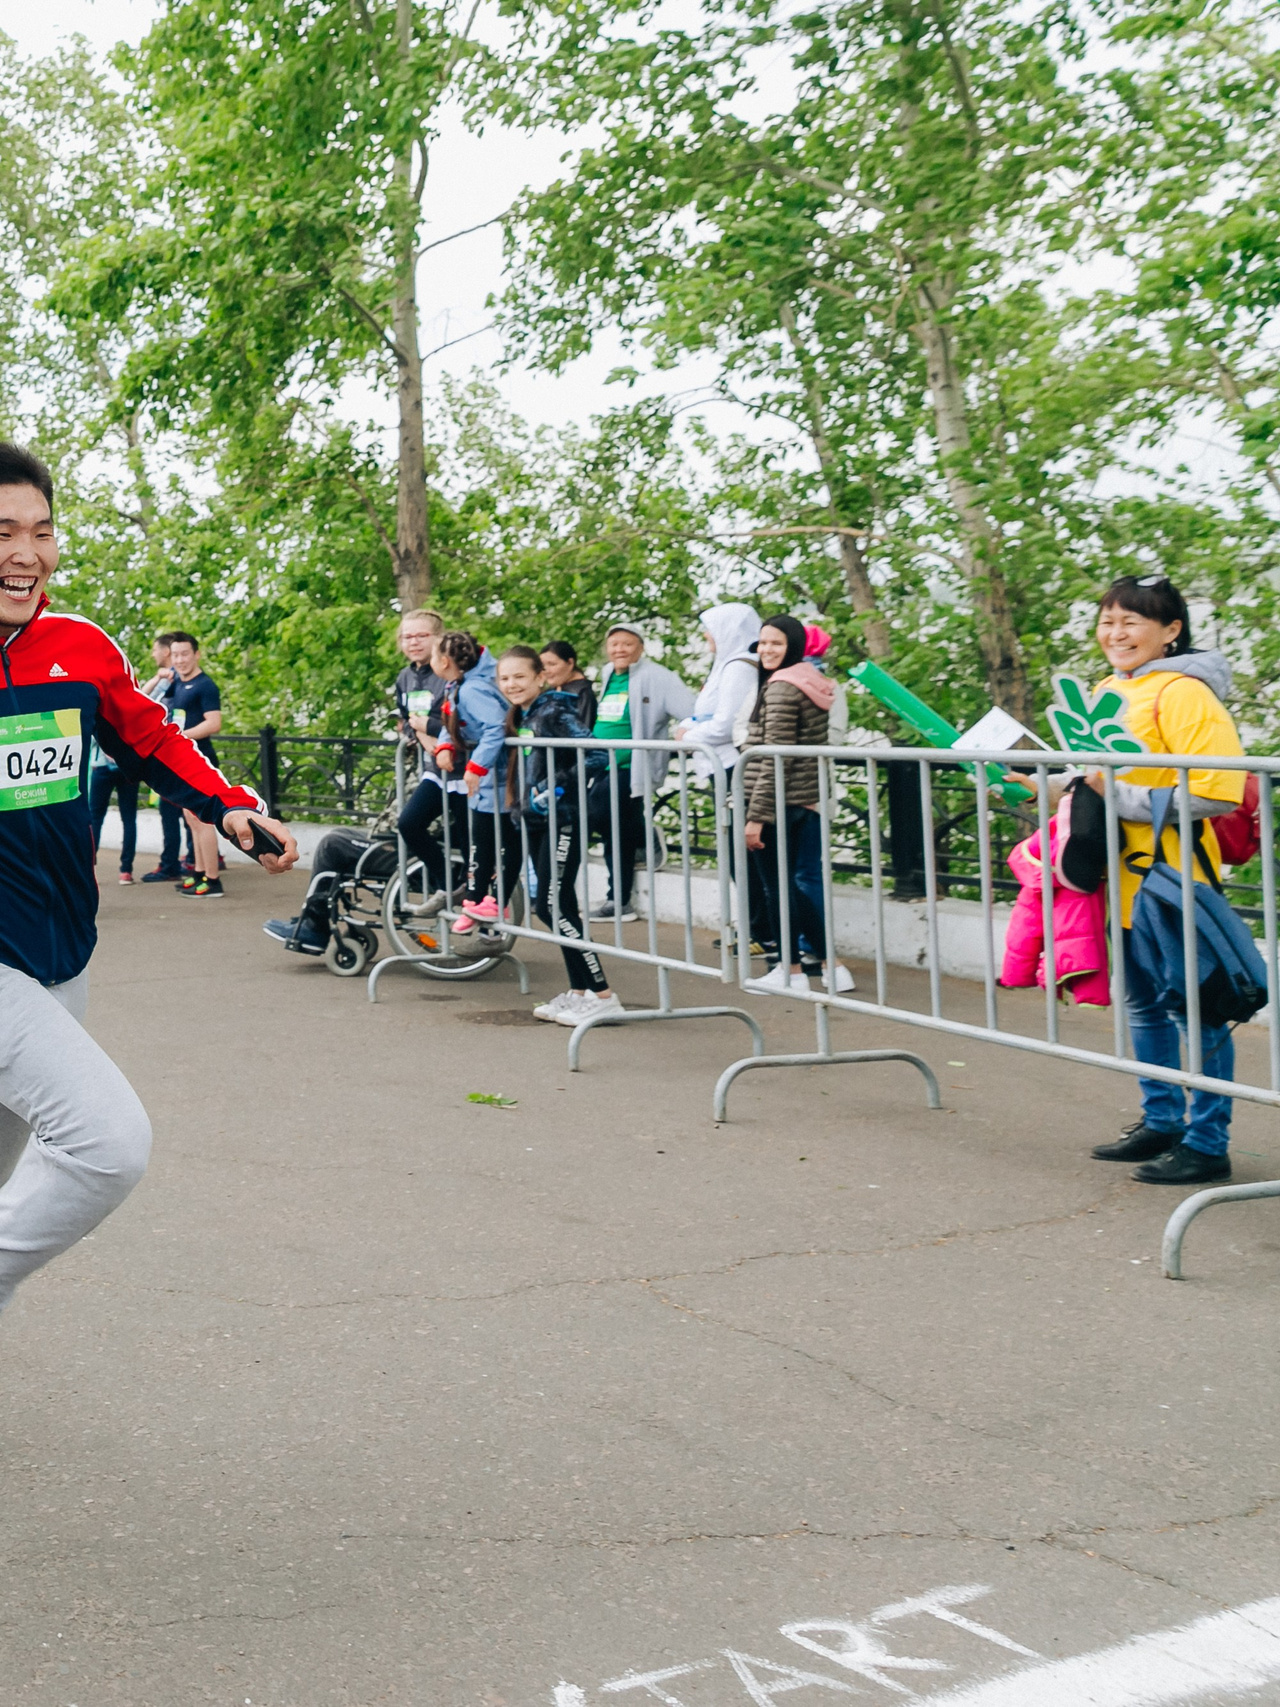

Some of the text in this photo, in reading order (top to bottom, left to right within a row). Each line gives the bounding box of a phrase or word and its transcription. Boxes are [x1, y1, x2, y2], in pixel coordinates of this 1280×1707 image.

[6, 744, 74, 780] 0424
[14, 787, 47, 800] бежим
[553, 1583, 1042, 1707] TART
